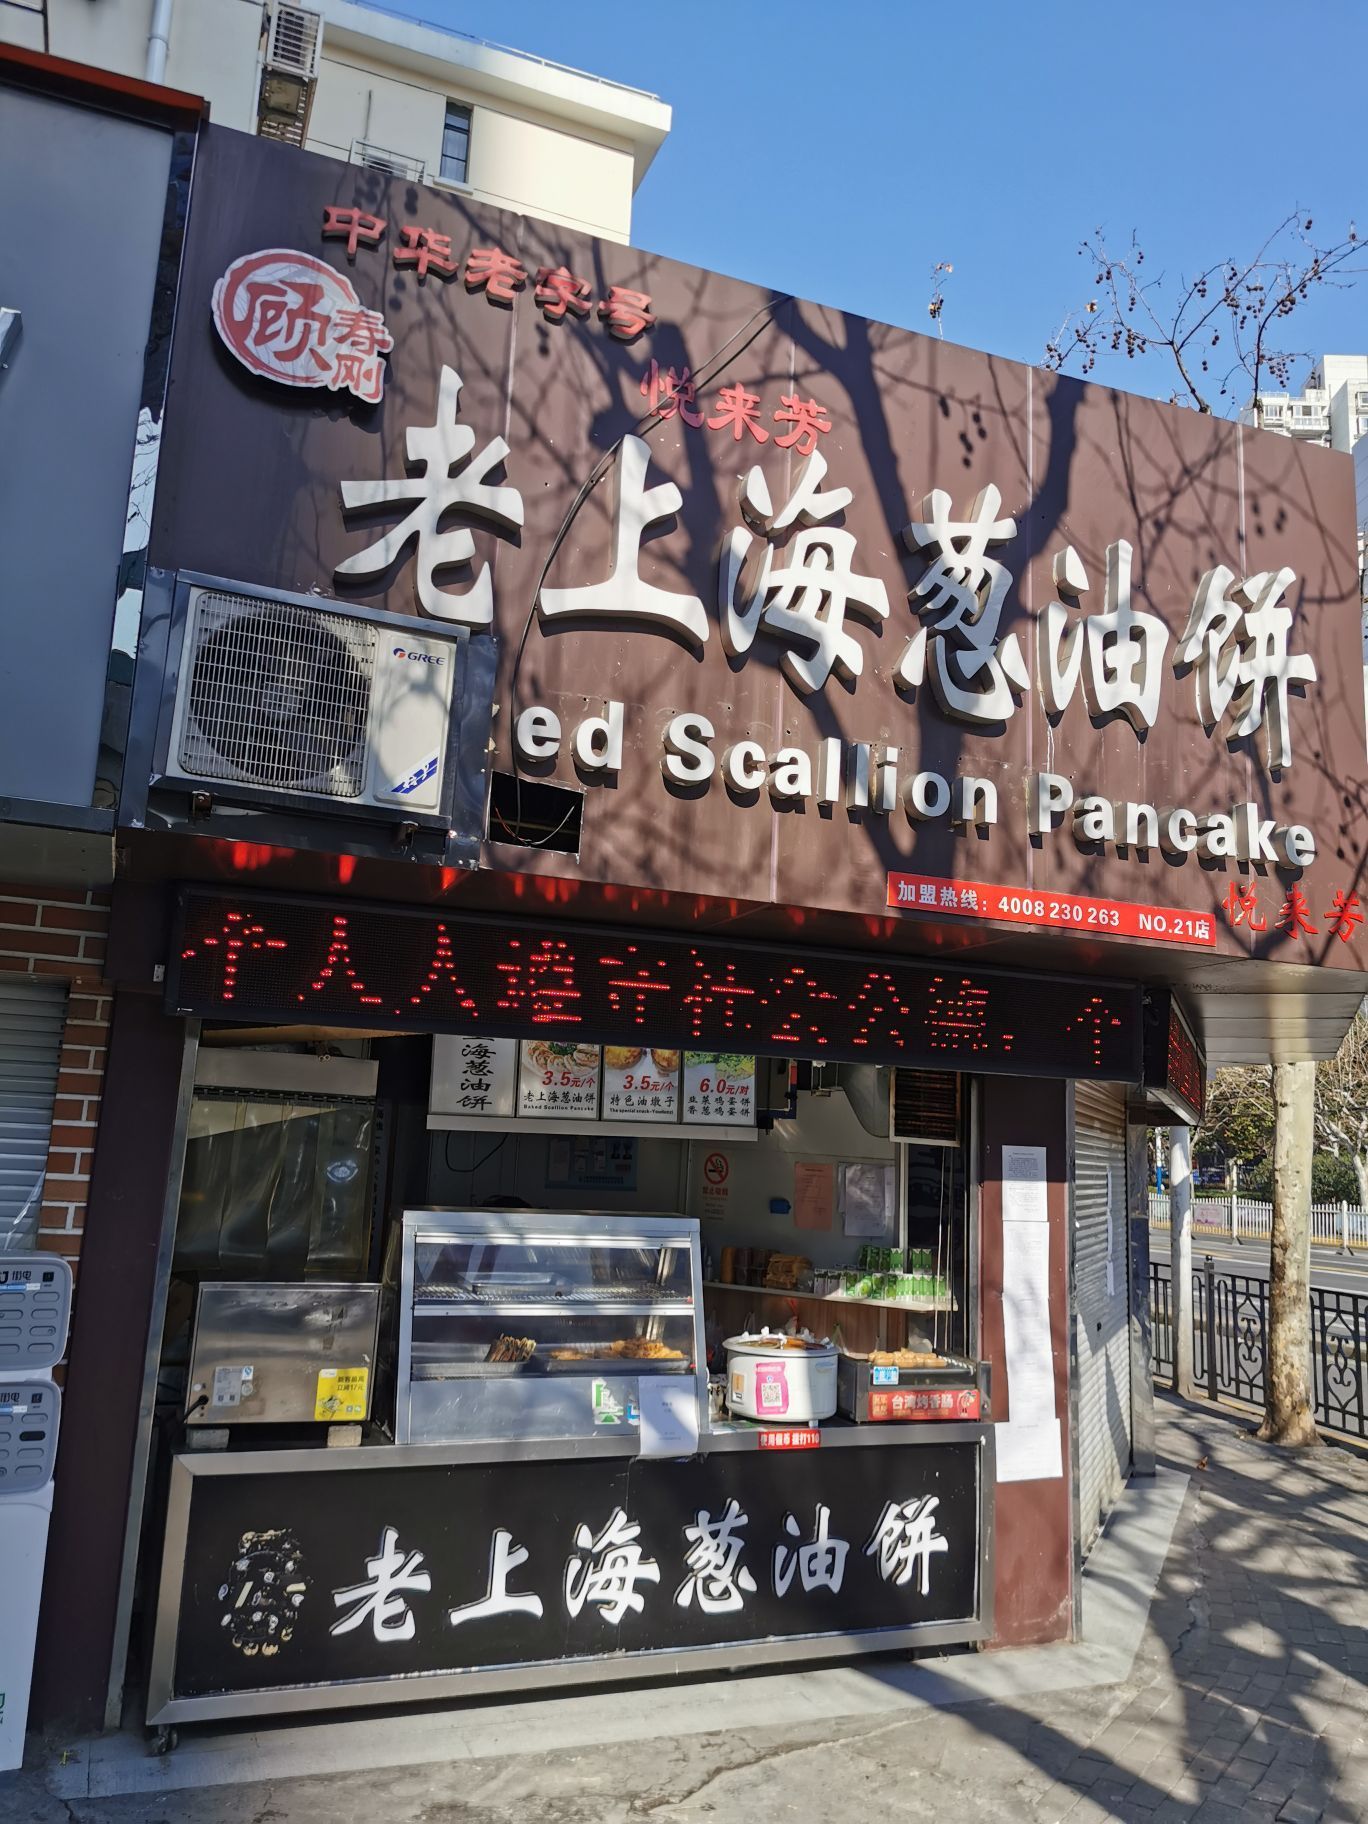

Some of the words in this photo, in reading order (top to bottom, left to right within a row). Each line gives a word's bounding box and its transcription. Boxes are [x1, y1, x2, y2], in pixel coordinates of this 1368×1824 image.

[323, 205, 654, 338] 中华老字号
[640, 358, 833, 456] 悦来芳
[334, 364, 1318, 769] 老上海葱油饼
[408, 651, 446, 666] GREE
[515, 698, 626, 773] ed
[664, 708, 999, 826] Scallion
[1030, 772, 1318, 868] Pancake
[997, 897, 1046, 918] 4008
[1048, 901, 1083, 922] 230
[1086, 905, 1120, 927] 263
[1138, 913, 1211, 941] NO.21店
[1222, 880, 1365, 943] 悦来芳
[523, 1089, 596, 1105] 老上海葱油饼
[542, 1071, 596, 1089] 3.5元/个
[623, 1074, 675, 1092] 3.5元/个
[700, 1078, 750, 1095] 6.0元/对
[330, 1495, 949, 1642] 老上海葱油饼
